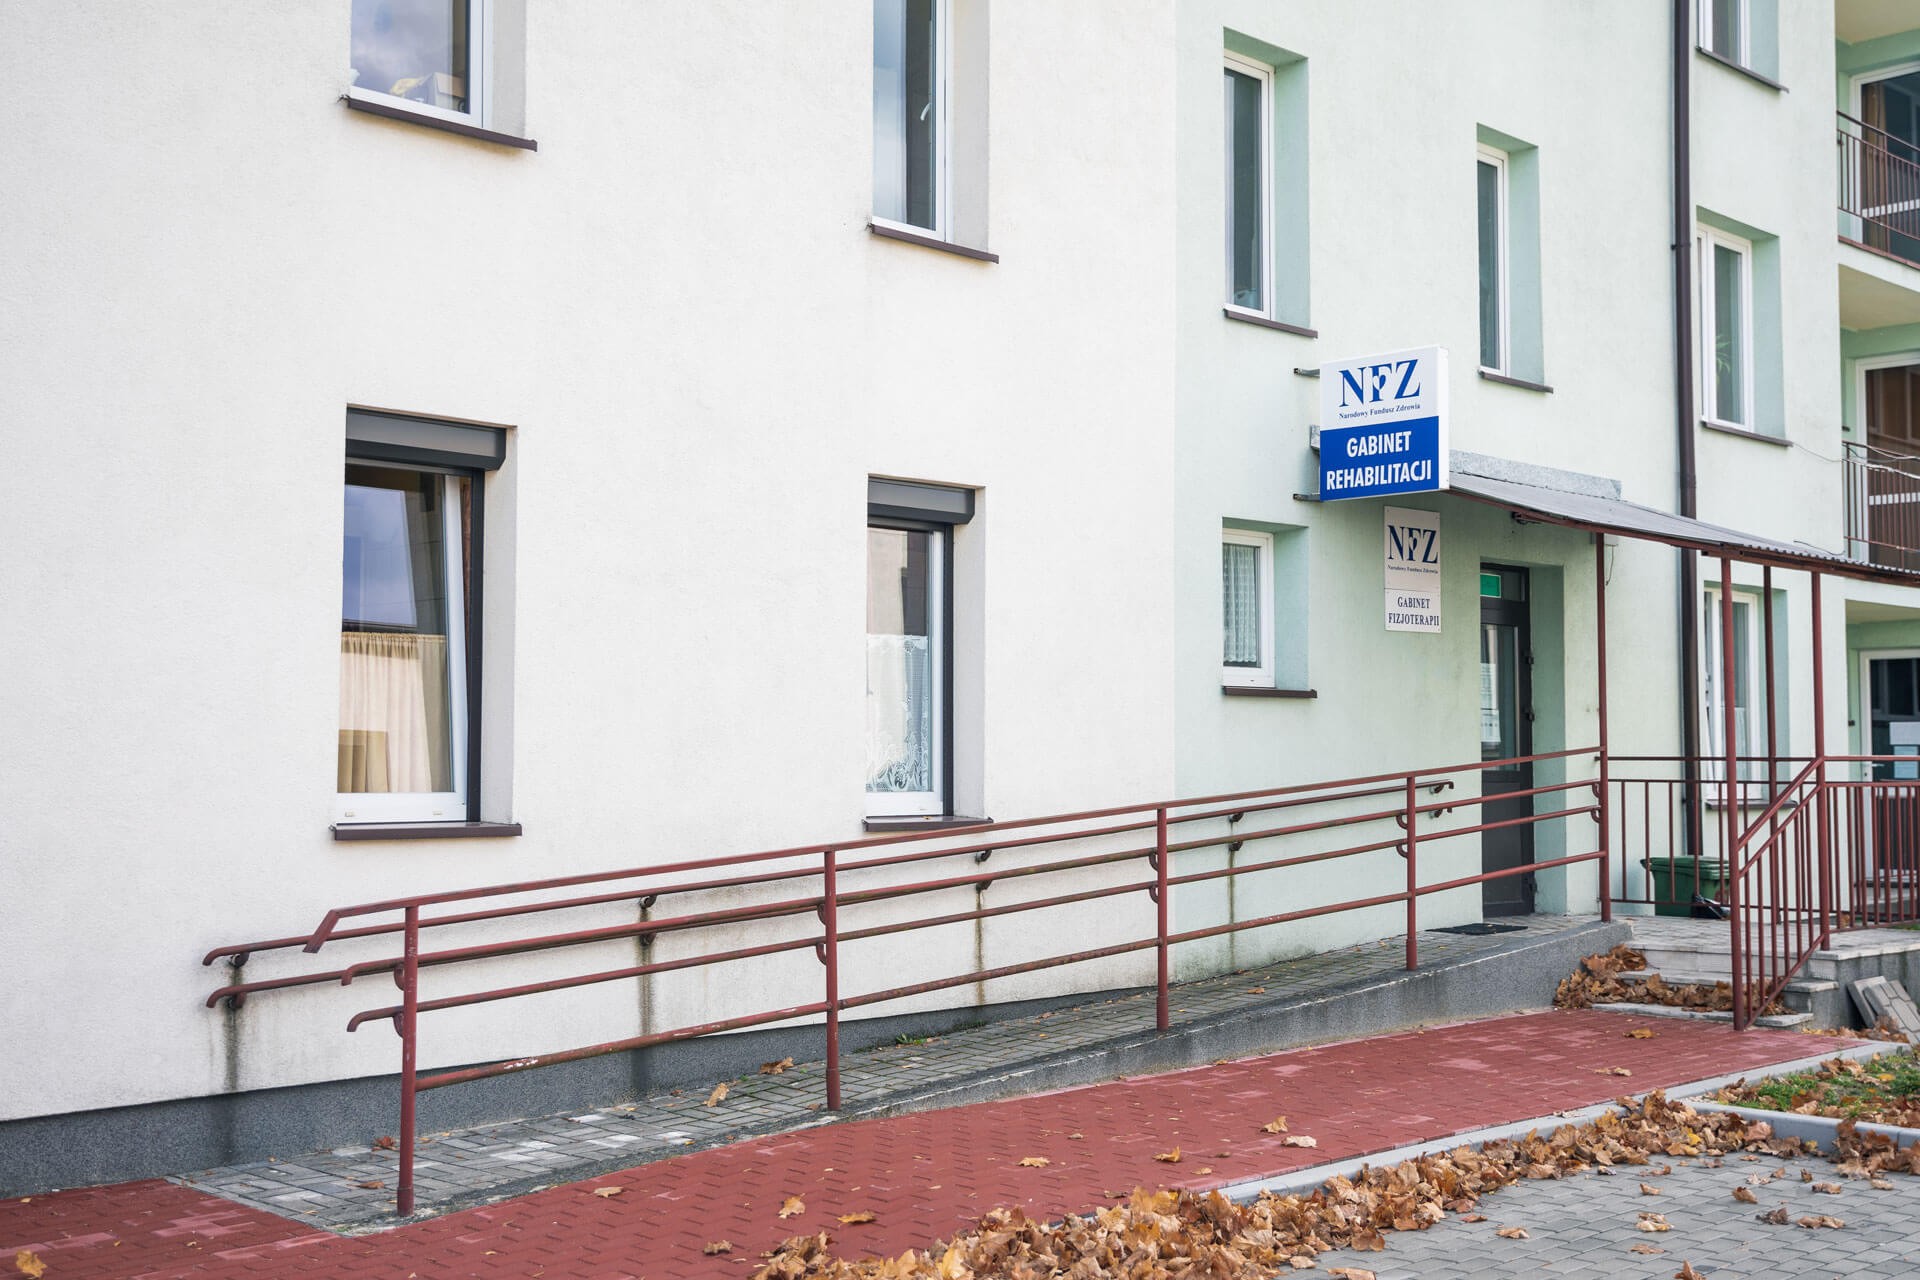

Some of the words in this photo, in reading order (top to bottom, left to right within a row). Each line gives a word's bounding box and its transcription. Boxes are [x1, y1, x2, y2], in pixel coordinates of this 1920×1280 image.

[1338, 359, 1421, 407] NFZ
[1338, 411, 1368, 419] Narodowy
[1369, 407, 1395, 416] Fundusz
[1396, 403, 1421, 412] Zdrowia
[1347, 430, 1411, 458] GABINET
[1326, 459, 1432, 491] REHABILITACJI
[1387, 525, 1439, 564] NFZ
[1397, 596, 1431, 609] GABINET
[1388, 612, 1440, 626] FIZJOTERAPII
